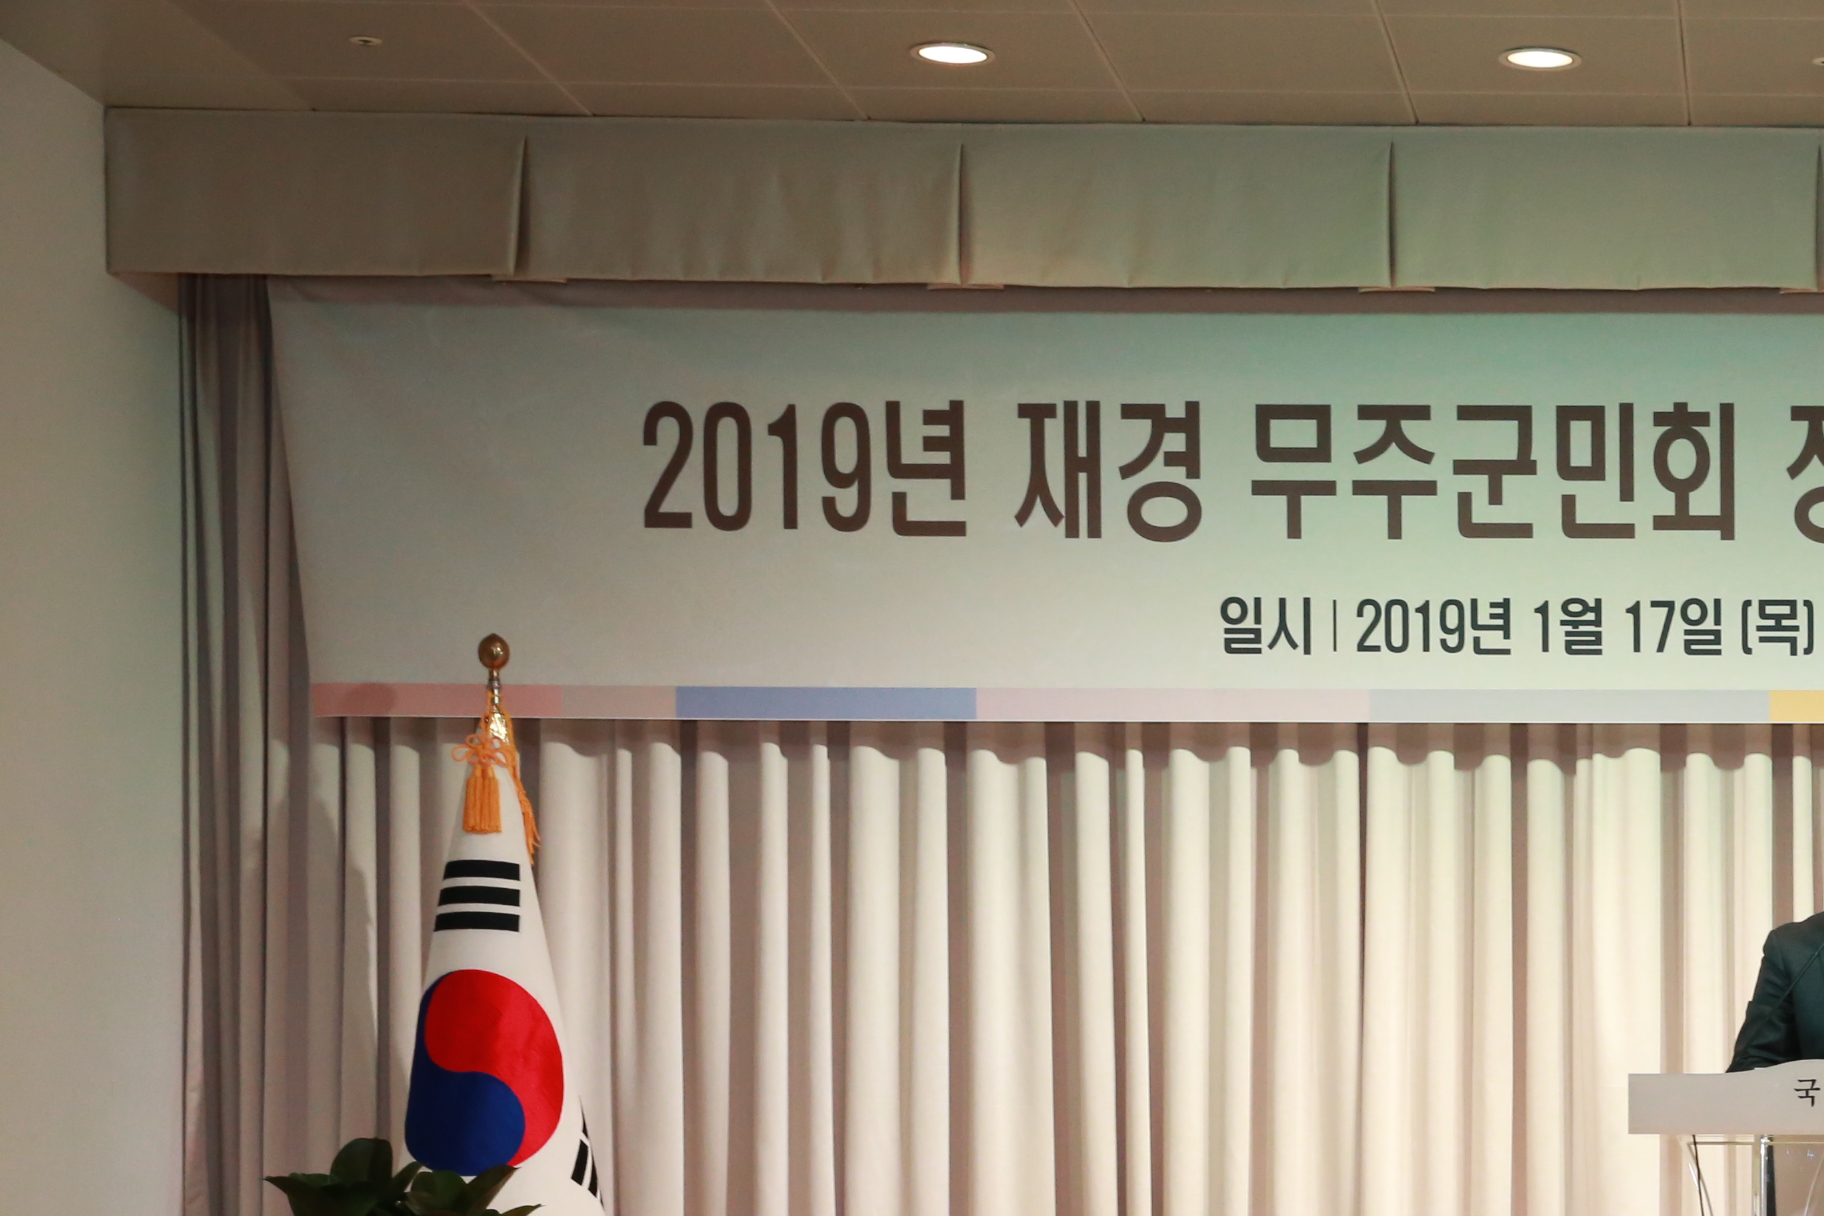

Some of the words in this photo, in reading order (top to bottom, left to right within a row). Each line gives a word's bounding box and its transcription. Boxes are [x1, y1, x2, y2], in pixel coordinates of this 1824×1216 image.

[642, 399, 968, 538] 2019년
[1013, 399, 1203, 543] 재경
[1250, 401, 1737, 541] 무주군민회
[1219, 595, 1312, 656] 일시
[1355, 597, 1512, 656] 2019년
[1533, 597, 1603, 656] 1월
[1624, 597, 1723, 656] 17일
